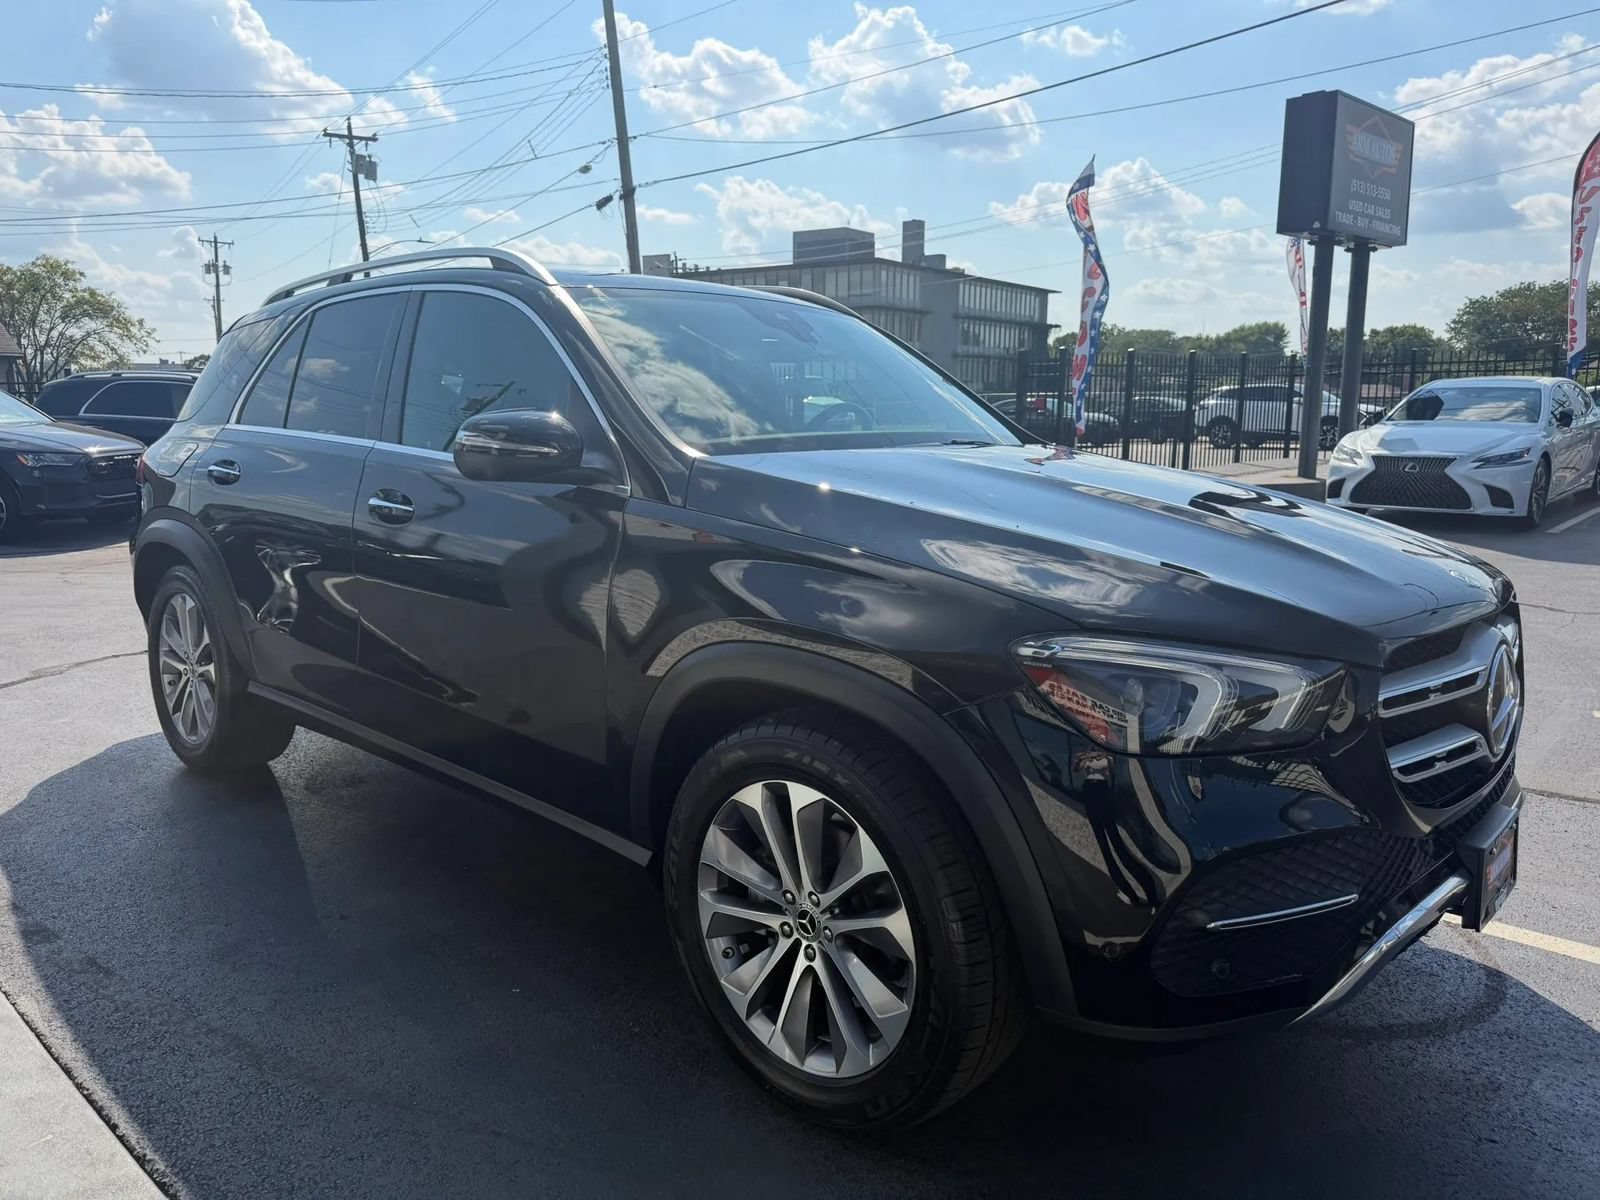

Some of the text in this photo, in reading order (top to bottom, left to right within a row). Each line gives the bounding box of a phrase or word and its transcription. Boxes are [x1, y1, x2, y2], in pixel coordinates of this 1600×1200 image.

[1348, 199, 1391, 219] USED CAR SALES
[1335, 211, 1401, 236] TRADE BUY FINANCING
